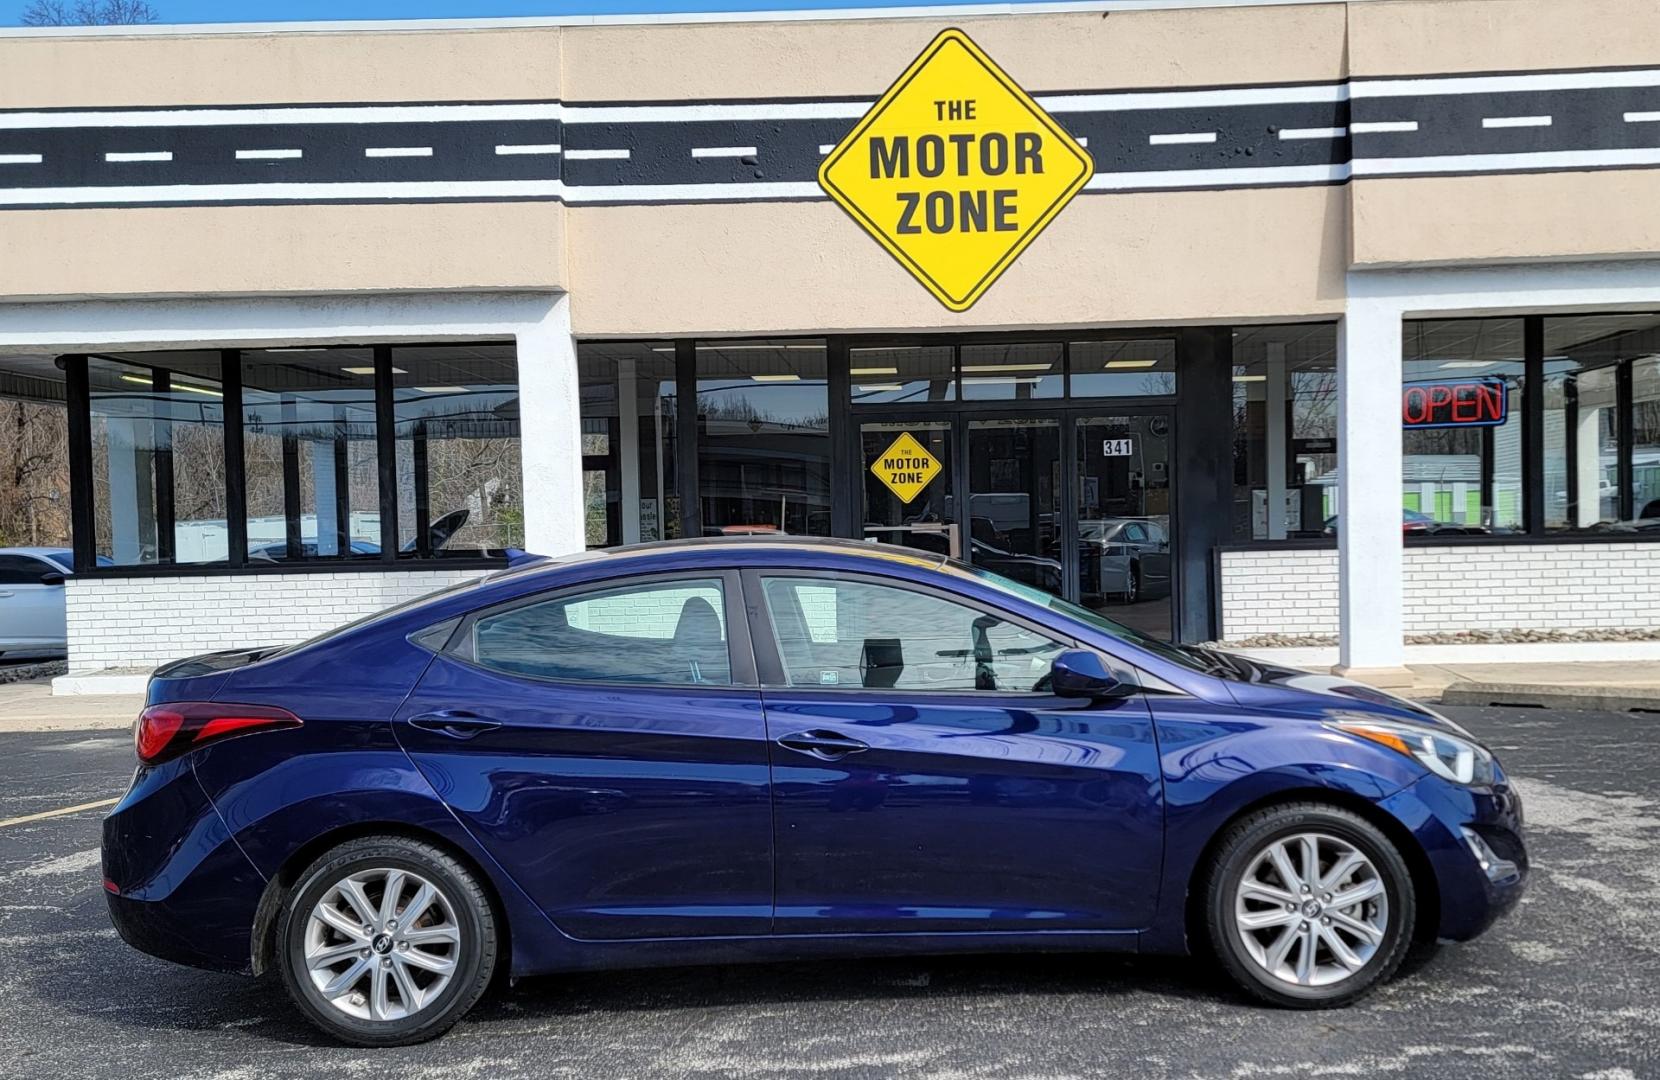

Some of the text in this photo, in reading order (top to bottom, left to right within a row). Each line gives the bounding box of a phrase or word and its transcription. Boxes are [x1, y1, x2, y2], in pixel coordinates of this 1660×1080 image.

[934, 99, 976, 121] THE
[869, 132, 1045, 179] MOTOR
[896, 189, 1019, 235] ZONE
[1403, 384, 1501, 423] OPEN
[1104, 440, 1131, 455] 341
[884, 457, 930, 470] MOTOR
[891, 472, 923, 484] ZONE
